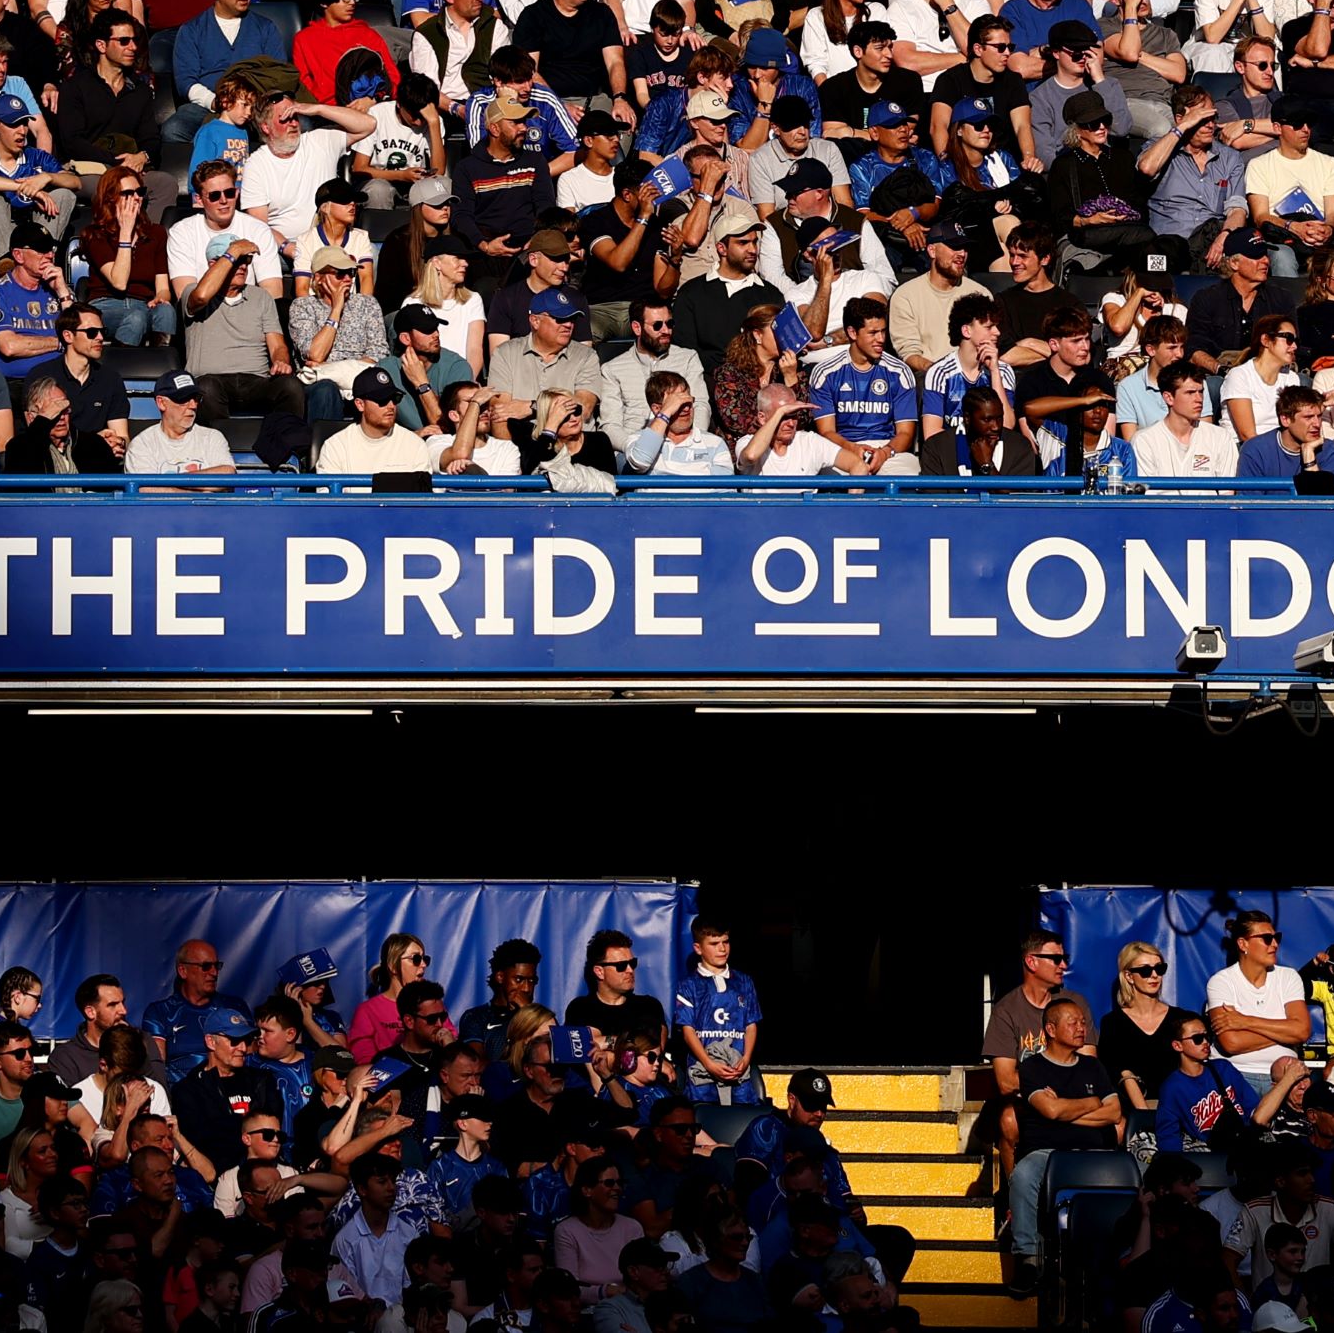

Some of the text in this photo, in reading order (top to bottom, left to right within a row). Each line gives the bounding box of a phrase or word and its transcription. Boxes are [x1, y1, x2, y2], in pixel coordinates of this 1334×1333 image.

[837, 400, 890, 414] SAMSUNG
[285, 537, 703, 636] PRIDE
[750, 535, 880, 605] OF
